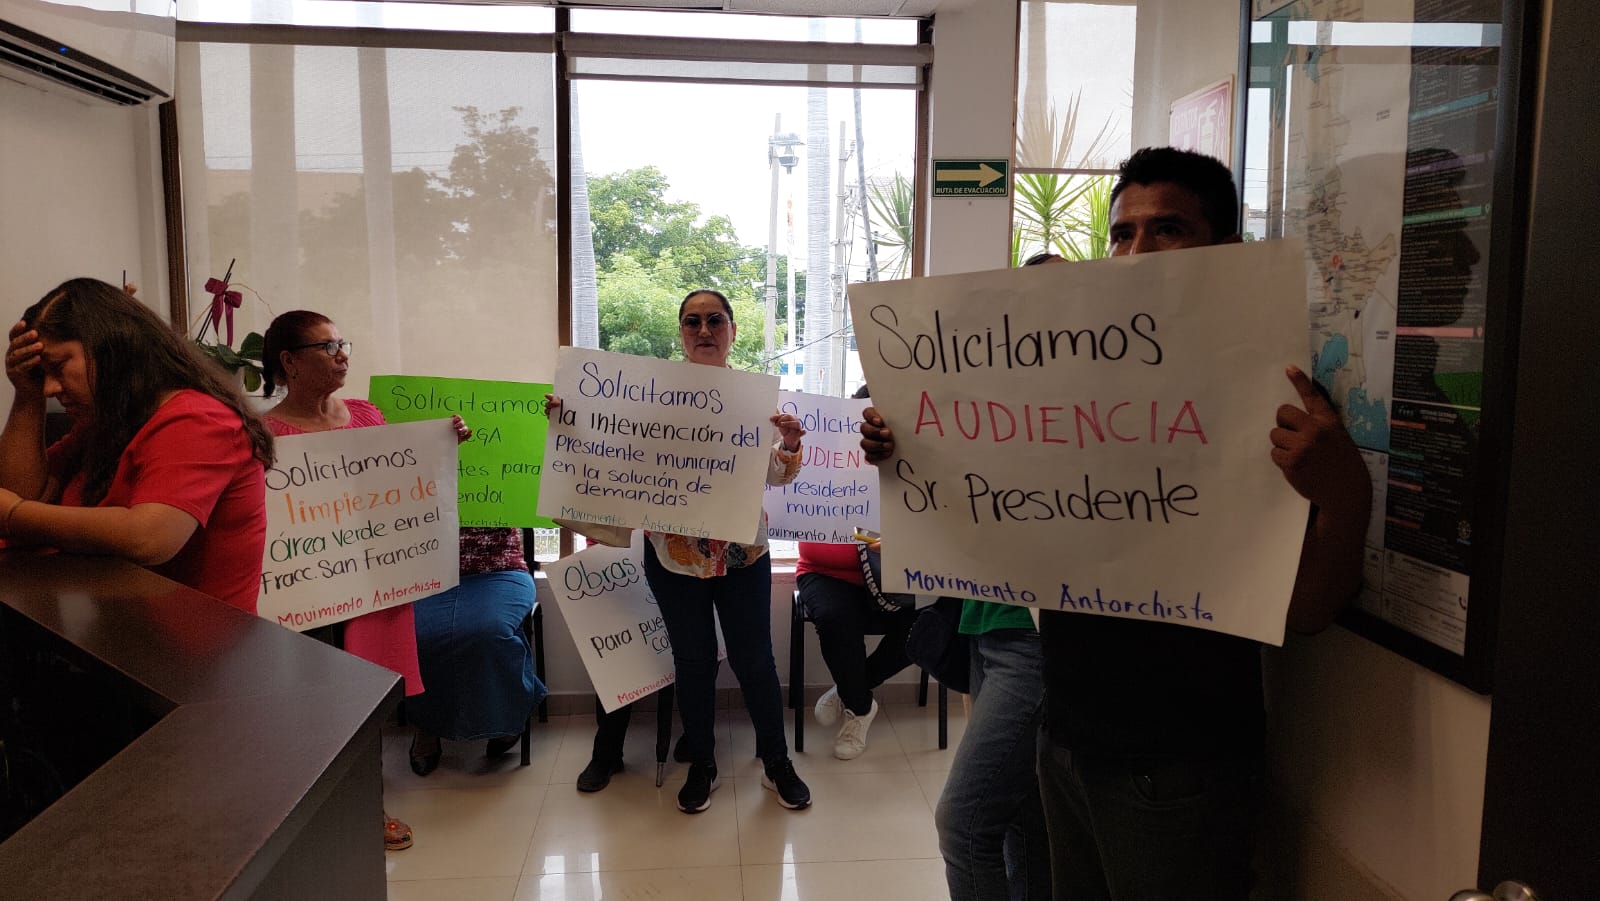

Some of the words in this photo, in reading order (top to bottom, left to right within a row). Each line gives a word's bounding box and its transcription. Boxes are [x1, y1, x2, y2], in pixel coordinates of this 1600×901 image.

[869, 304, 1163, 374] Solicitamos
[578, 361, 724, 415] Solicitamos
[558, 398, 576, 427] la
[731, 426, 760, 448] del
[914, 390, 1209, 449] AUDIENCIA
[501, 463, 541, 480] para
[552, 460, 576, 476] en
[582, 462, 600, 480] la
[608, 469, 679, 491] solución
[686, 475, 713, 495] de
[656, 451, 737, 475] municipal
[284, 488, 402, 525] limpieza
[409, 475, 439, 498] de
[575, 481, 689, 507] demandas
[896, 459, 949, 514] Sr.
[964, 466, 1200, 524] Presidente
[393, 515, 420, 531] en
[422, 507, 441, 524] el
[786, 500, 870, 520] municipal
[321, 556, 358, 580] San
[363, 537, 440, 571] Francisco
[277, 596, 363, 627] Movimiento
[372, 578, 442, 607] Antorchista
[903, 567, 1037, 604] Movimiento
[1058, 582, 1214, 622] Antorchista
[590, 628, 633, 659] para
